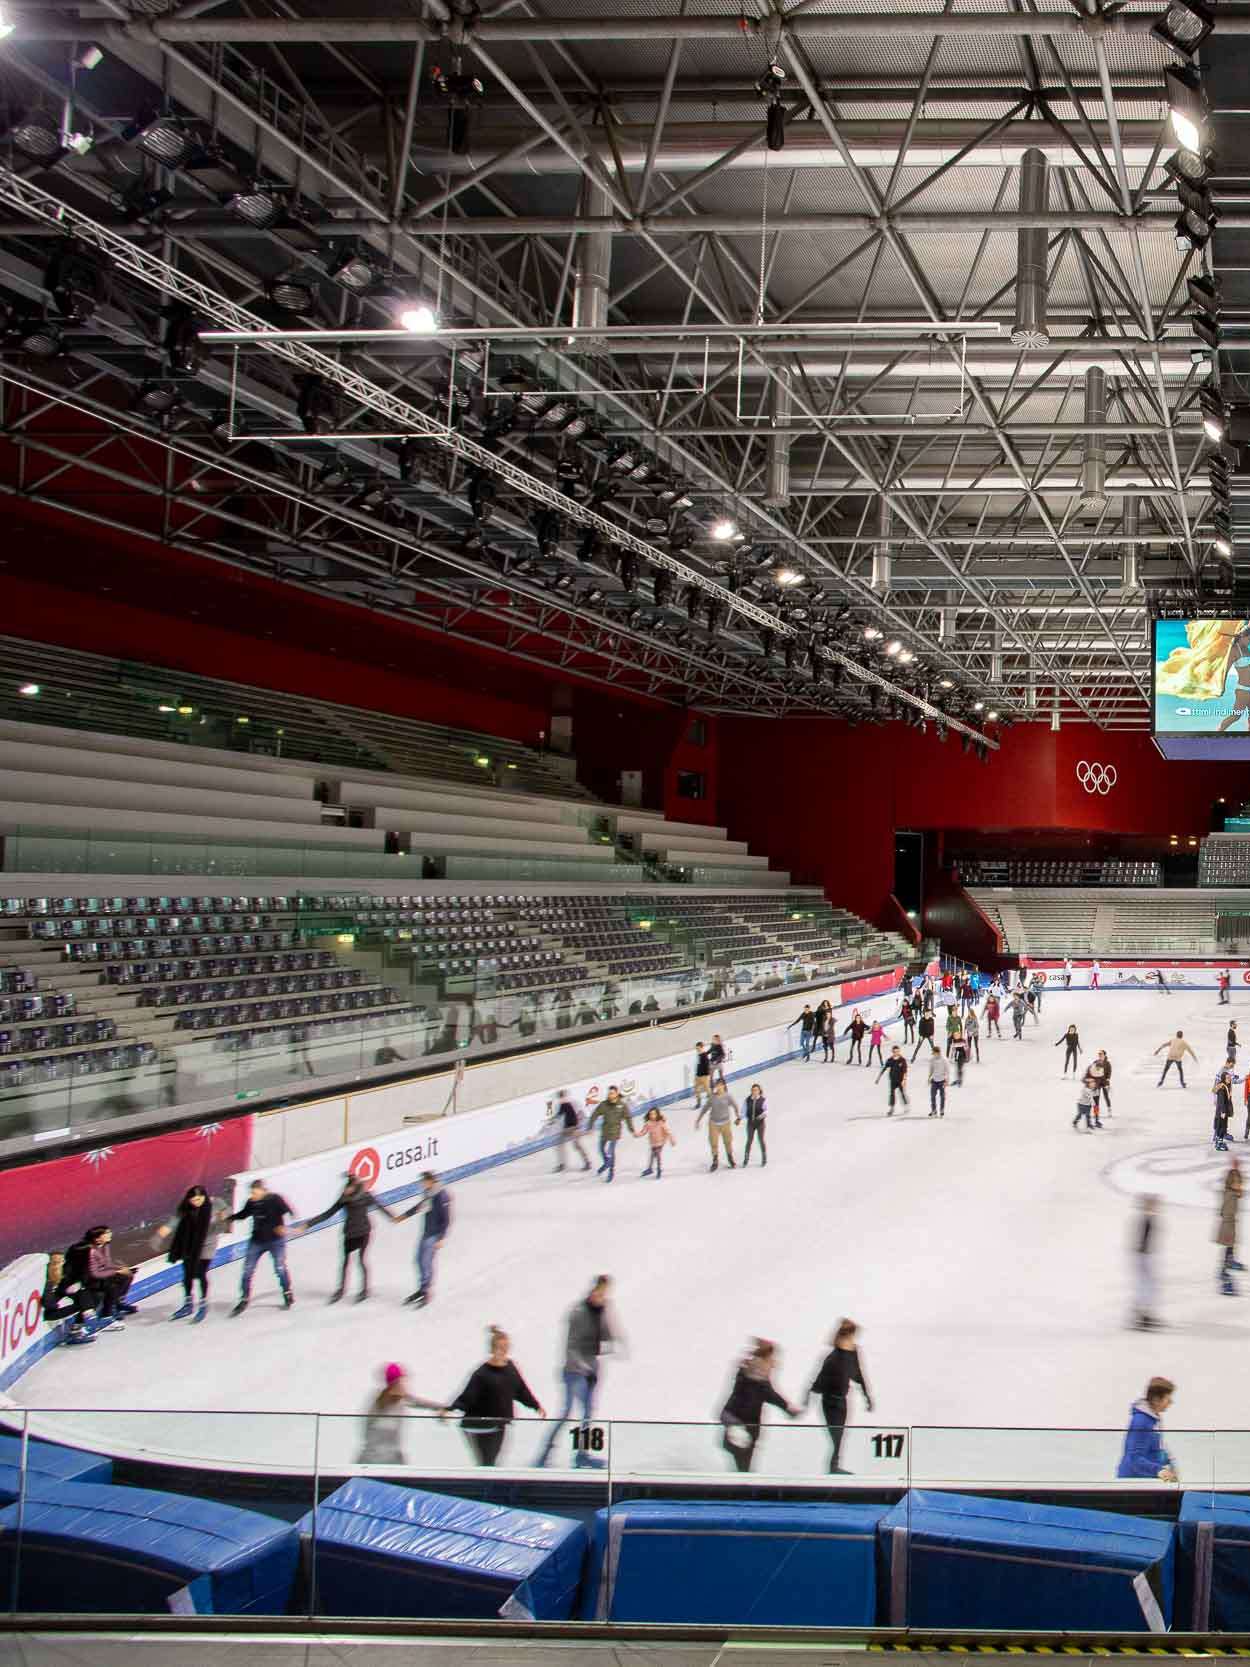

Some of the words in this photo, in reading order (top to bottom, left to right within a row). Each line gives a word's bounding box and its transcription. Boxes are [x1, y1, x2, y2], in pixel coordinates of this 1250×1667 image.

[386, 1136, 439, 1170] casa.it
[0, 1289, 42, 1360] ico
[569, 1426, 604, 1451] 118
[871, 1433, 905, 1458] 117
